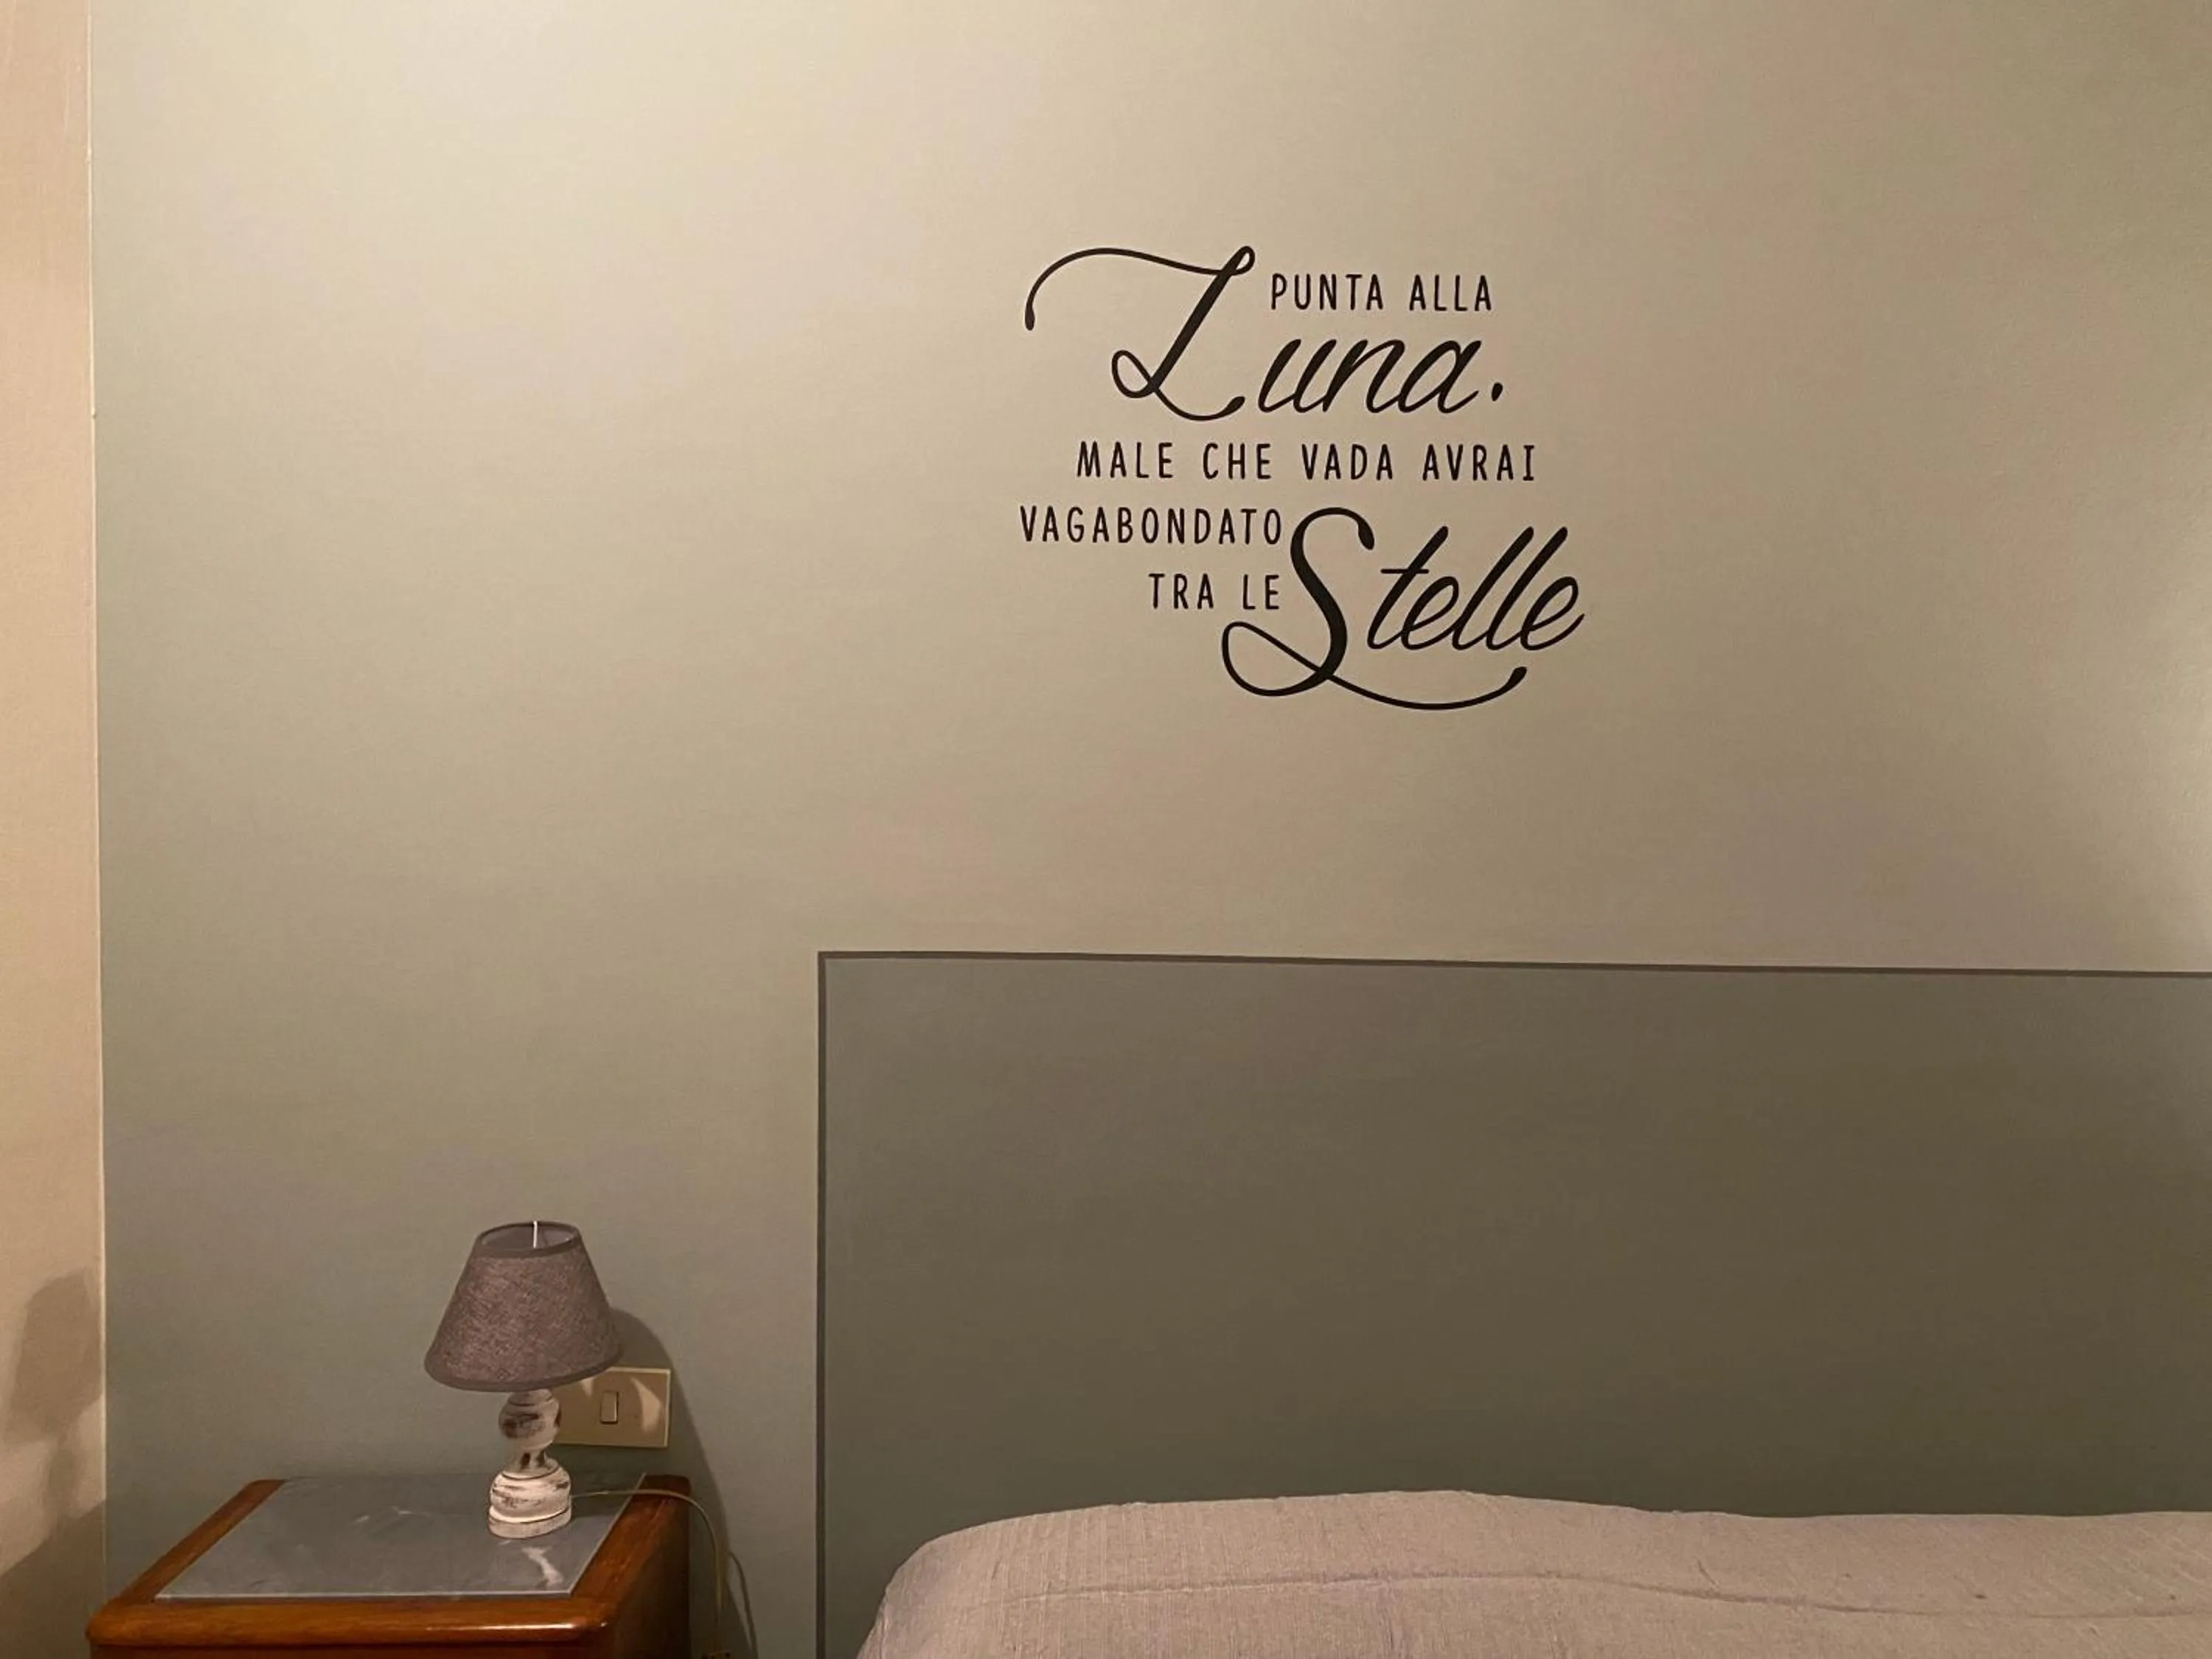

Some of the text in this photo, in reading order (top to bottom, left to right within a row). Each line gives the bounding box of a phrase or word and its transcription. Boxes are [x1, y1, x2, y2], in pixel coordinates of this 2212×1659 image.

[1270, 273, 1492, 313] PUNTA ALLA
[1024, 246, 1504, 422] Luna.
[1077, 440, 1535, 482] MALE CHE VADA AVRAI
[1019, 505, 1281, 546] VAGABONDATO
[1147, 572, 1280, 611] TRA LE
[1221, 507, 1586, 712] Stelle
